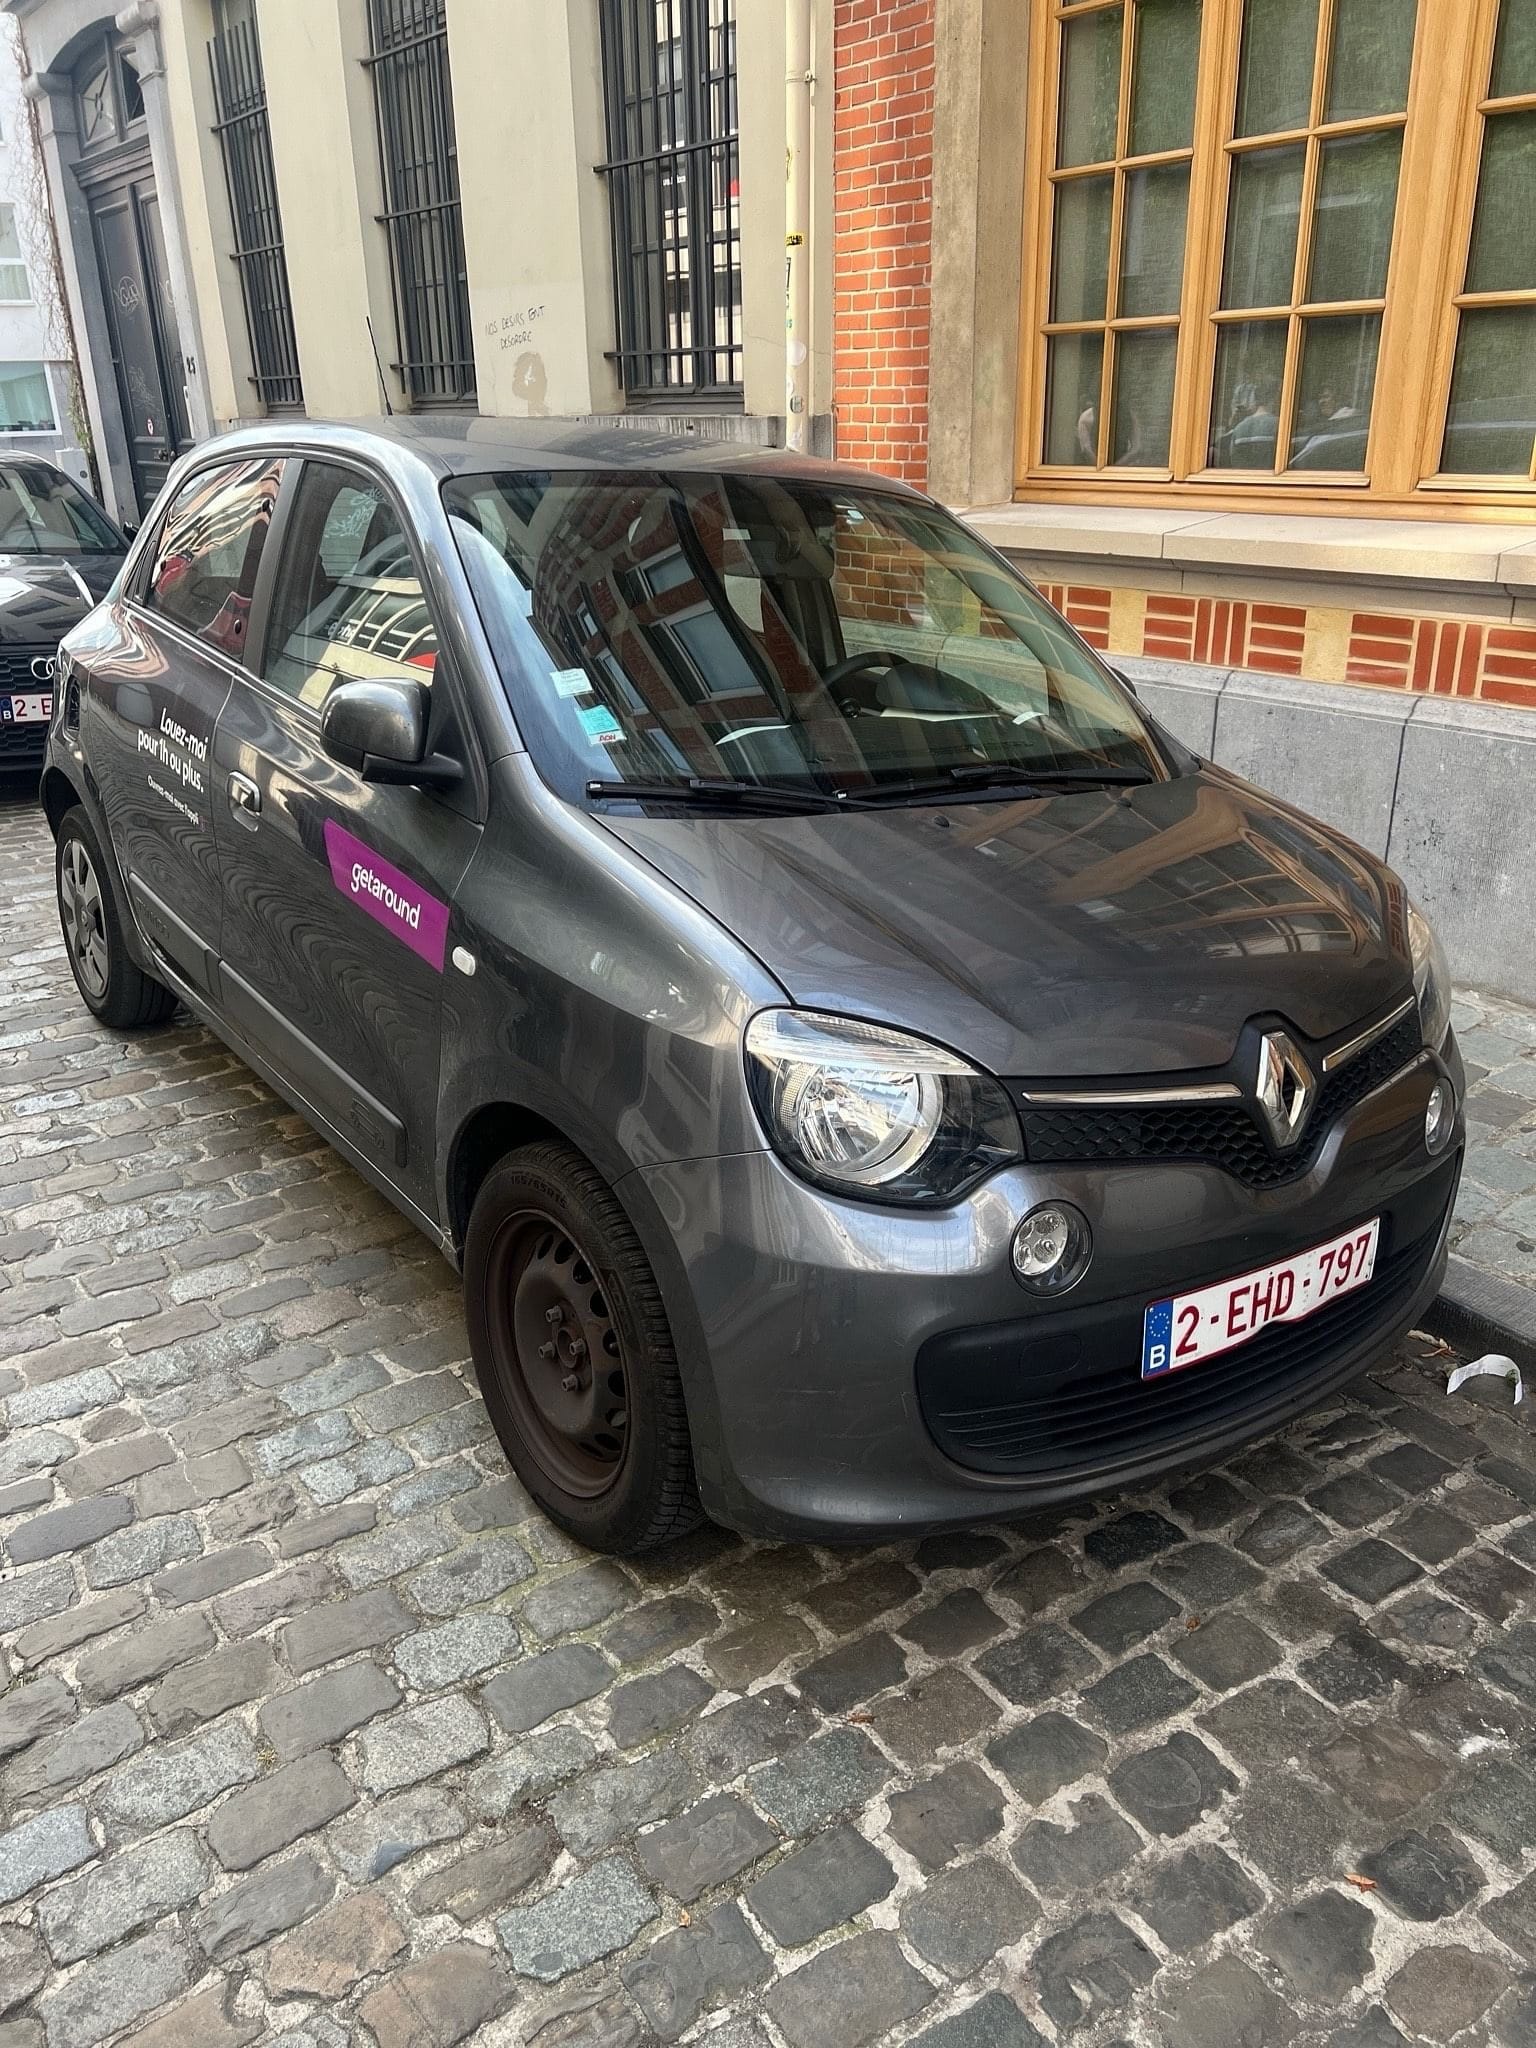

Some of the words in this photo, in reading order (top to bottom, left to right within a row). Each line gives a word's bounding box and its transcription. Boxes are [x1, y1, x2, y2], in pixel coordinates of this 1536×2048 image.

[3, 710, 12, 720] B
[159, 707, 208, 762] Louez-moi
[138, 729, 159, 756] pour
[159, 738, 169, 766] 1h
[169, 752, 181, 775] ou
[182, 759, 204, 793] plus.
[350, 862, 421, 930] getaround
[1150, 1343, 1166, 1368] B
